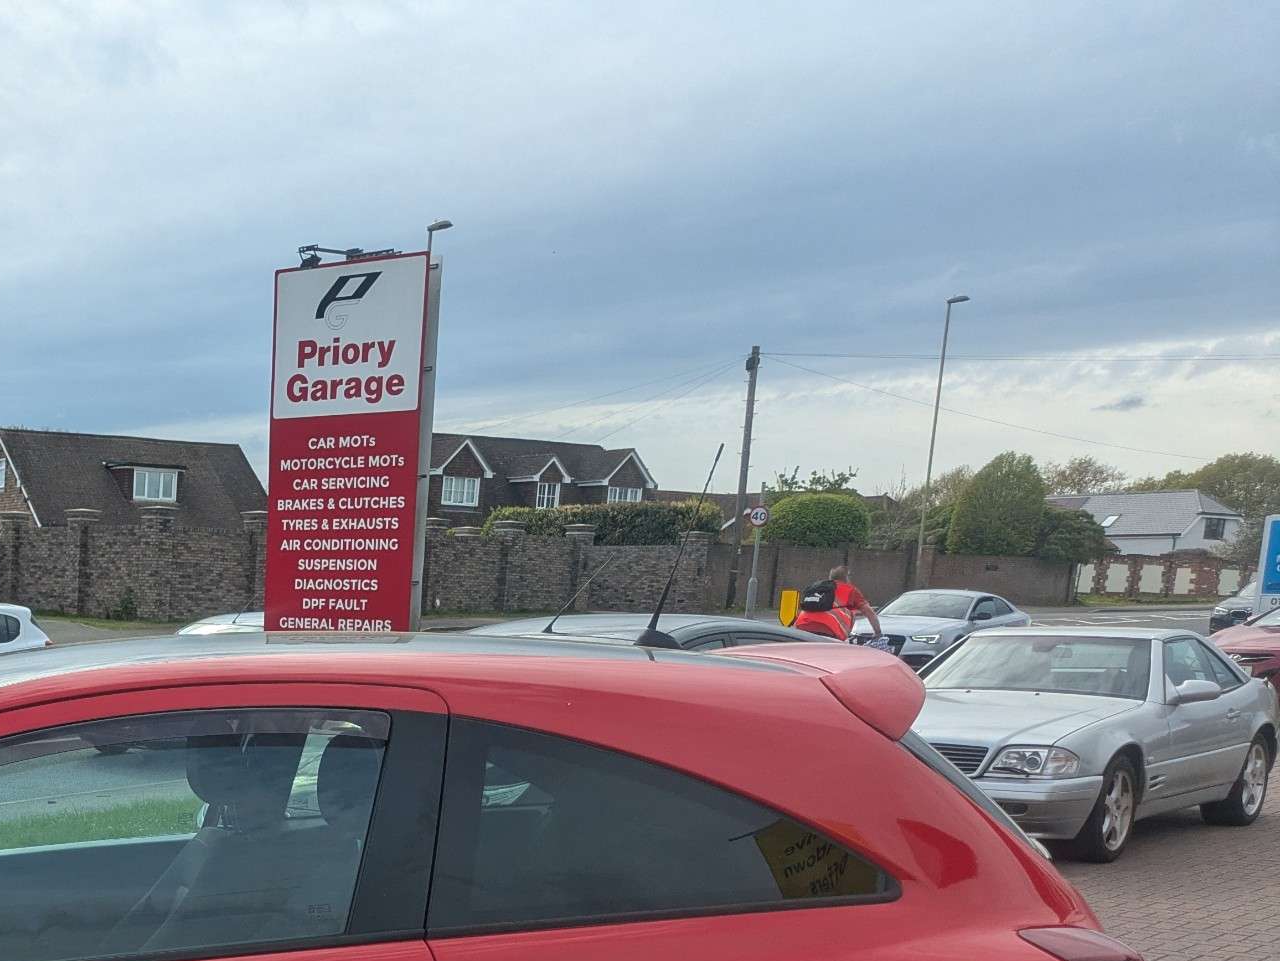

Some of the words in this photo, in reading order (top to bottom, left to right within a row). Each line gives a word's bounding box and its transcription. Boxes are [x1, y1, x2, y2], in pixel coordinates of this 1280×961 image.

[297, 337, 396, 369] Priory
[286, 373, 405, 404] Garage
[308, 436, 336, 450] CAR
[338, 434, 376, 449] MOTs
[280, 456, 365, 472] MOTORCYCLE
[368, 454, 405, 468] MOTs
[292, 478, 318, 491] CAR
[321, 475, 390, 490] SERVICING
[277, 498, 325, 511] BRAKES
[326, 497, 336, 510] &
[338, 496, 406, 510] CLUTCHES
[752, 511, 767, 521] 40
[281, 518, 319, 531] TYRES
[320, 518, 330, 531] &
[332, 517, 399, 530] EXHAUSTS
[280, 539, 301, 551] AIR
[303, 538, 399, 551] CONDITIONING
[297, 558, 378, 571] SUSPENSION
[294, 578, 378, 591] DIAGNOSTICS
[302, 597, 326, 610] DPF
[328, 598, 368, 611] FAULT
[279, 617, 335, 630] GENERAL
[337, 619, 392, 632] REPAIRS
